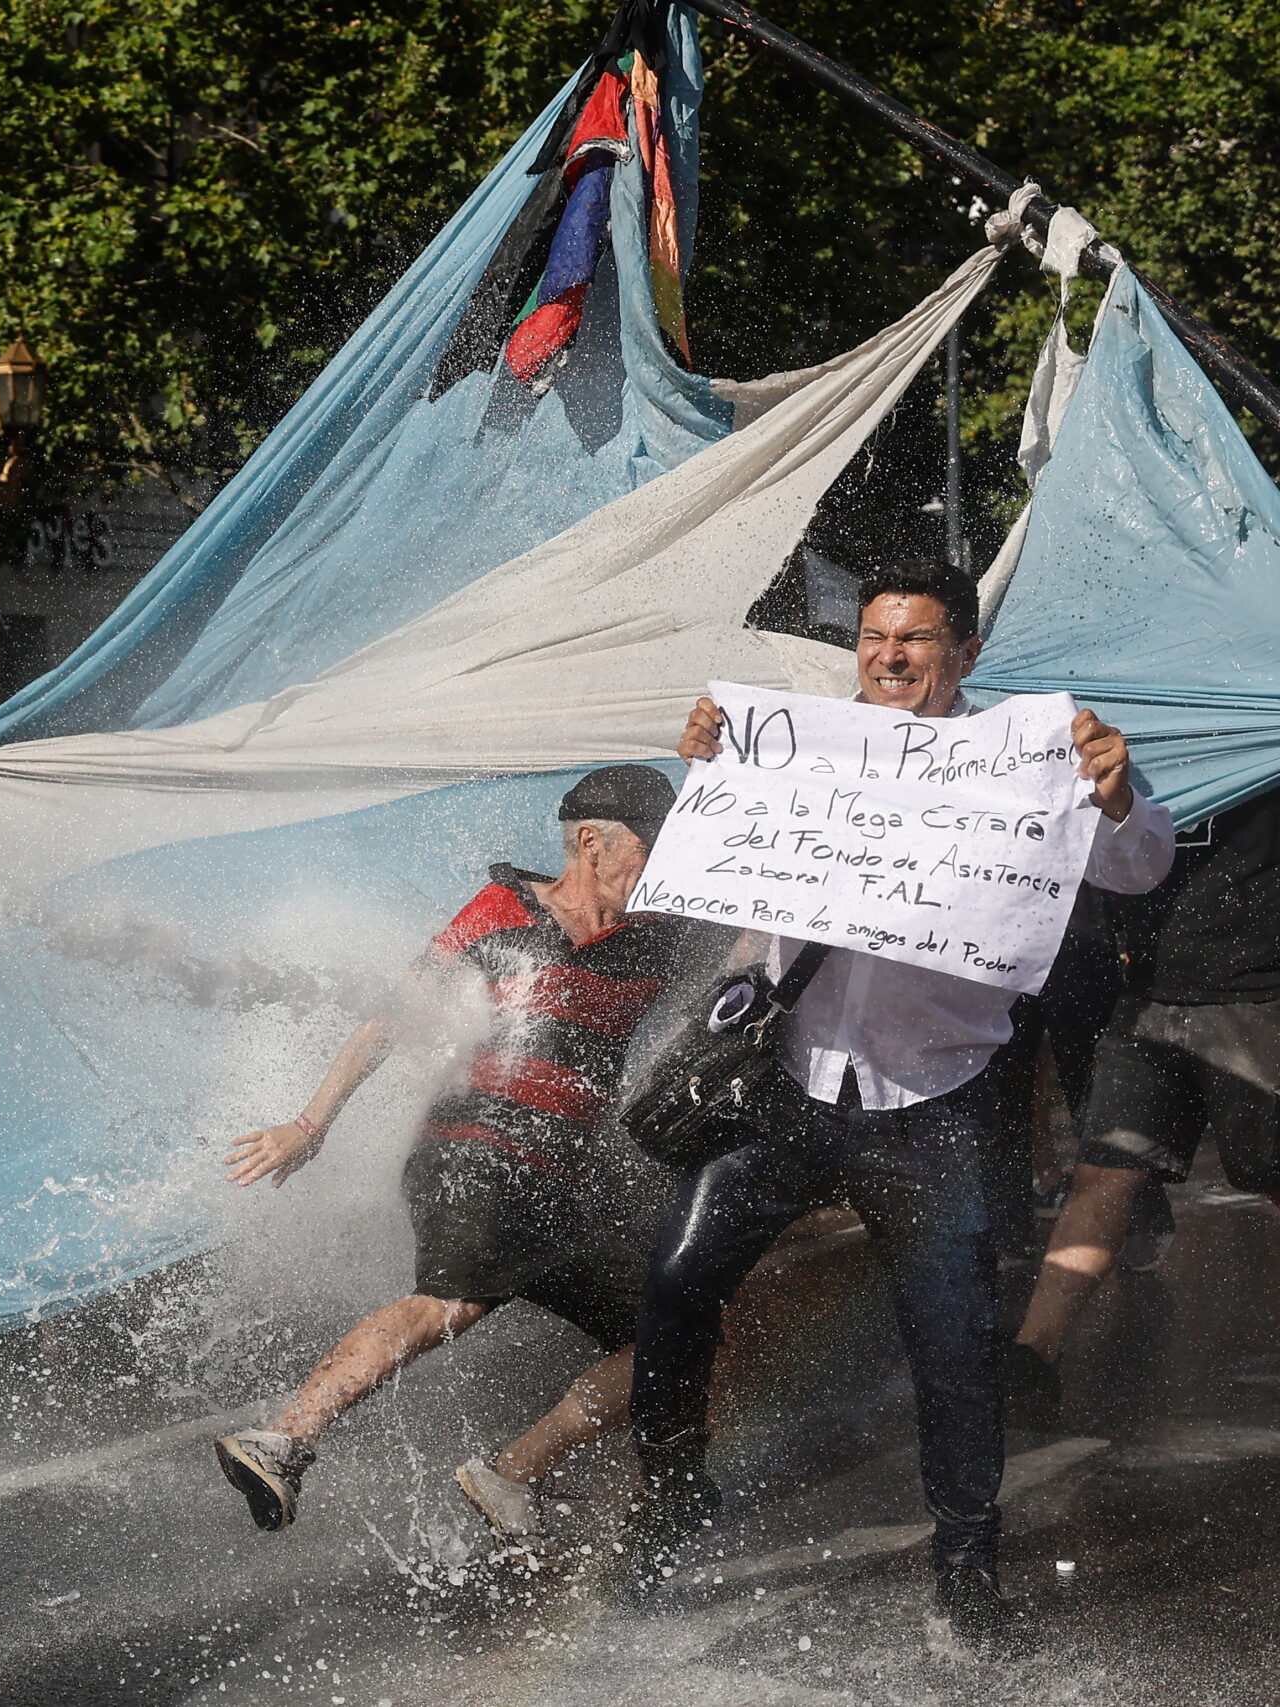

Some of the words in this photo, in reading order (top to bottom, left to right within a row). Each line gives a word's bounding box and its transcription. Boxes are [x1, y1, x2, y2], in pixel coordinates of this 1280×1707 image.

[709, 705, 797, 770] NO
[810, 756, 836, 773] a
[850, 736, 880, 779] la
[676, 779, 737, 817] NO
[745, 801, 769, 816] a
[790, 789, 810, 817] la
[827, 788, 903, 839] Mega
[705, 856, 828, 886] Laboral
[723, 822, 779, 850] del
[893, 851, 918, 871] de
[632, 880, 738, 913] Negocio
[807, 905, 832, 931] los
[847, 923, 906, 951] amigos
[916, 930, 949, 955] del
[963, 942, 1018, 973] Poder
